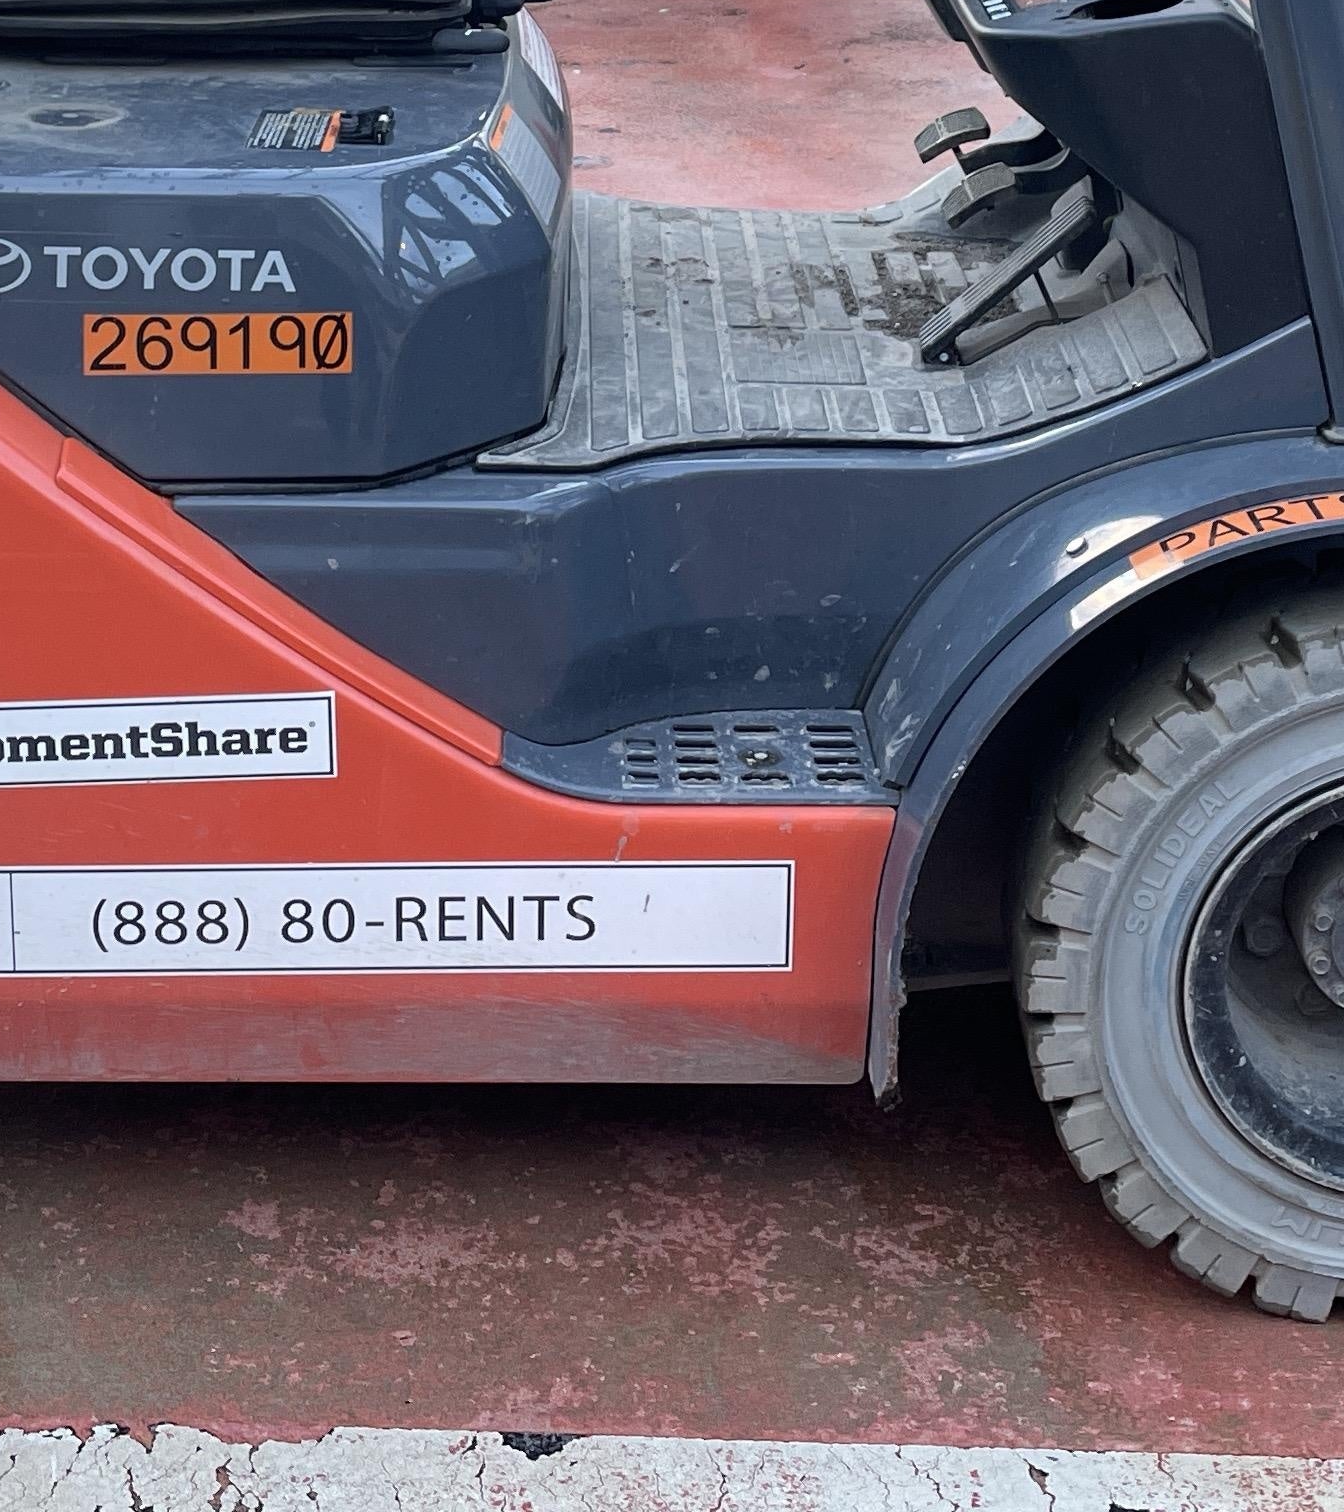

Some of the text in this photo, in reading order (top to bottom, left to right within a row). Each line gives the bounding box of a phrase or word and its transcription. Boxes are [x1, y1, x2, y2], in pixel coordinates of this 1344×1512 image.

[44, 245, 297, 293] TOYOTA
[89, 312, 349, 371] 269190
[1124, 780, 1248, 936] SOLIDEAL
[91, 893, 598, 953] (888) 80-RENTS
